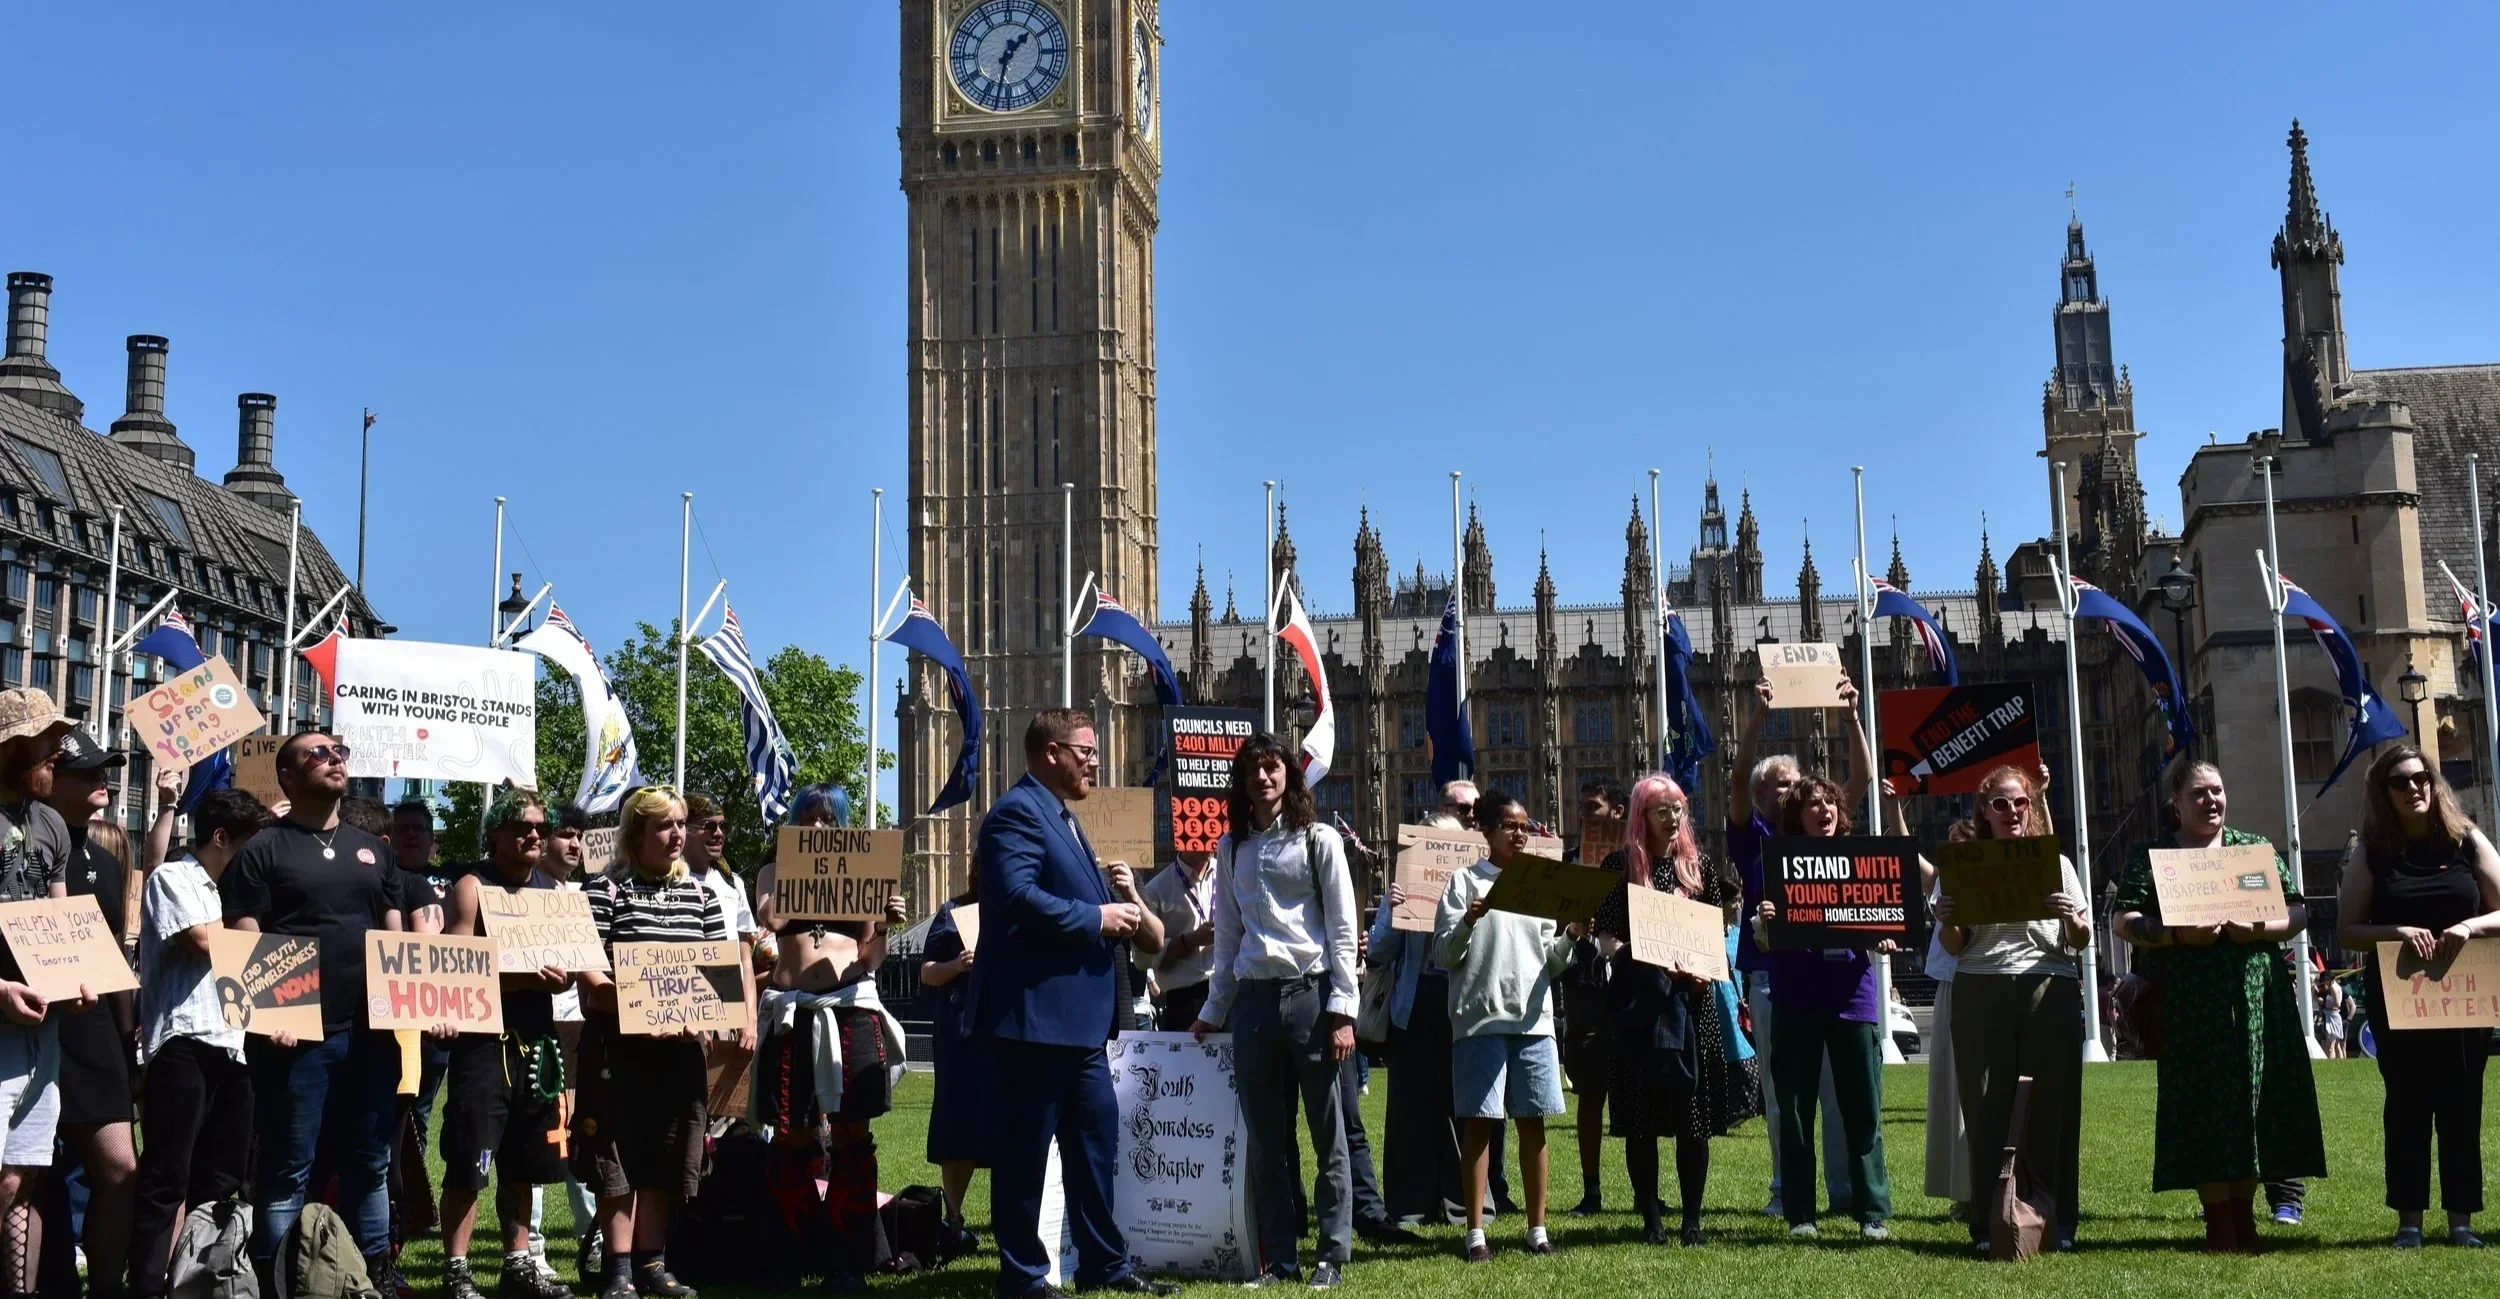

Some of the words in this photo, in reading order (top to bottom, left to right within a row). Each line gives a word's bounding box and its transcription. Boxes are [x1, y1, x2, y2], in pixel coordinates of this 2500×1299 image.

[1783, 646, 1818, 663] END
[149, 666, 213, 718] Stand
[336, 684, 397, 701] CARING
[402, 689, 417, 702] IN
[421, 692, 478, 710] BRISTOL
[481, 699, 532, 717] STANDS
[362, 702, 399, 716] WITH
[403, 705, 457, 722] YOUNG
[461, 711, 510, 728] PEOPLE
[1919, 724, 1950, 749] END
[1947, 700, 1980, 729] THE
[336, 723, 406, 743] YOUTH
[1173, 718, 1224, 735] COUNCILS
[1225, 720, 1252, 736] NEED
[1932, 720, 1990, 769] BENEFIT
[1986, 695, 2024, 730] TRAP
[242, 738, 276, 757] GIVE
[346, 743, 428, 761] HAPTER
[1175, 735, 1206, 751] £400
[1176, 758, 1188, 770] TO
[1189, 759, 1210, 771] HELP
[1211, 760, 1228, 772] END
[798, 830, 871, 854] HOUSING
[1426, 841, 1451, 851] DON'T
[1454, 844, 1471, 853] LET
[1997, 839, 2042, 860] THE
[1436, 855, 1449, 864] BE
[1456, 856, 1475, 865] THE
[2188, 848, 2208, 860] LET
[2215, 847, 2252, 858] YOUNG
[815, 857, 828, 875] IS
[837, 856, 847, 874] A
[1782, 856, 1788, 879] I
[1792, 856, 1850, 879] STAND
[1854, 856, 1900, 879] WITH
[2189, 860, 2226, 873] PEOPLE
[484, 891, 529, 914] END
[537, 892, 589, 914] YOUTH
[776, 878, 839, 915] HUMAN
[841, 878, 898, 915] RIGHT
[1784, 884, 1837, 905] YOUNG
[1842, 883, 1902, 904] PEOPLE
[63, 910, 104, 928] YOUNG
[1787, 908, 1823, 922] FACING
[1825, 908, 1905, 922] HOMELESSNESS
[36, 932, 66, 945] LIVE
[71, 927, 94, 943] FOR
[488, 922, 597, 949] HOMELESSNESS
[243, 963, 262, 984] END
[263, 939, 298, 967] YOUTH
[377, 940, 422, 974] WE
[428, 944, 491, 977] DESERVE
[619, 948, 641, 967] WE
[647, 948, 697, 966] SHOULD
[702, 946, 721, 961] BE
[1640, 940, 1695, 968] HOUSING
[246, 941, 318, 997] HOMELESSNESS
[640, 965, 689, 979] ALLOWED
[273, 967, 319, 1007] NOW
[638, 976, 706, 998] THRIVE
[388, 980, 492, 1022] HOMES
[629, 1000, 643, 1009] NOT
[657, 998, 680, 1007] JUST
[1128, 1062, 1194, 1105] Youth
[1121, 1103, 1215, 1145] Homeless
[1128, 1146, 1204, 1185] Chapter
